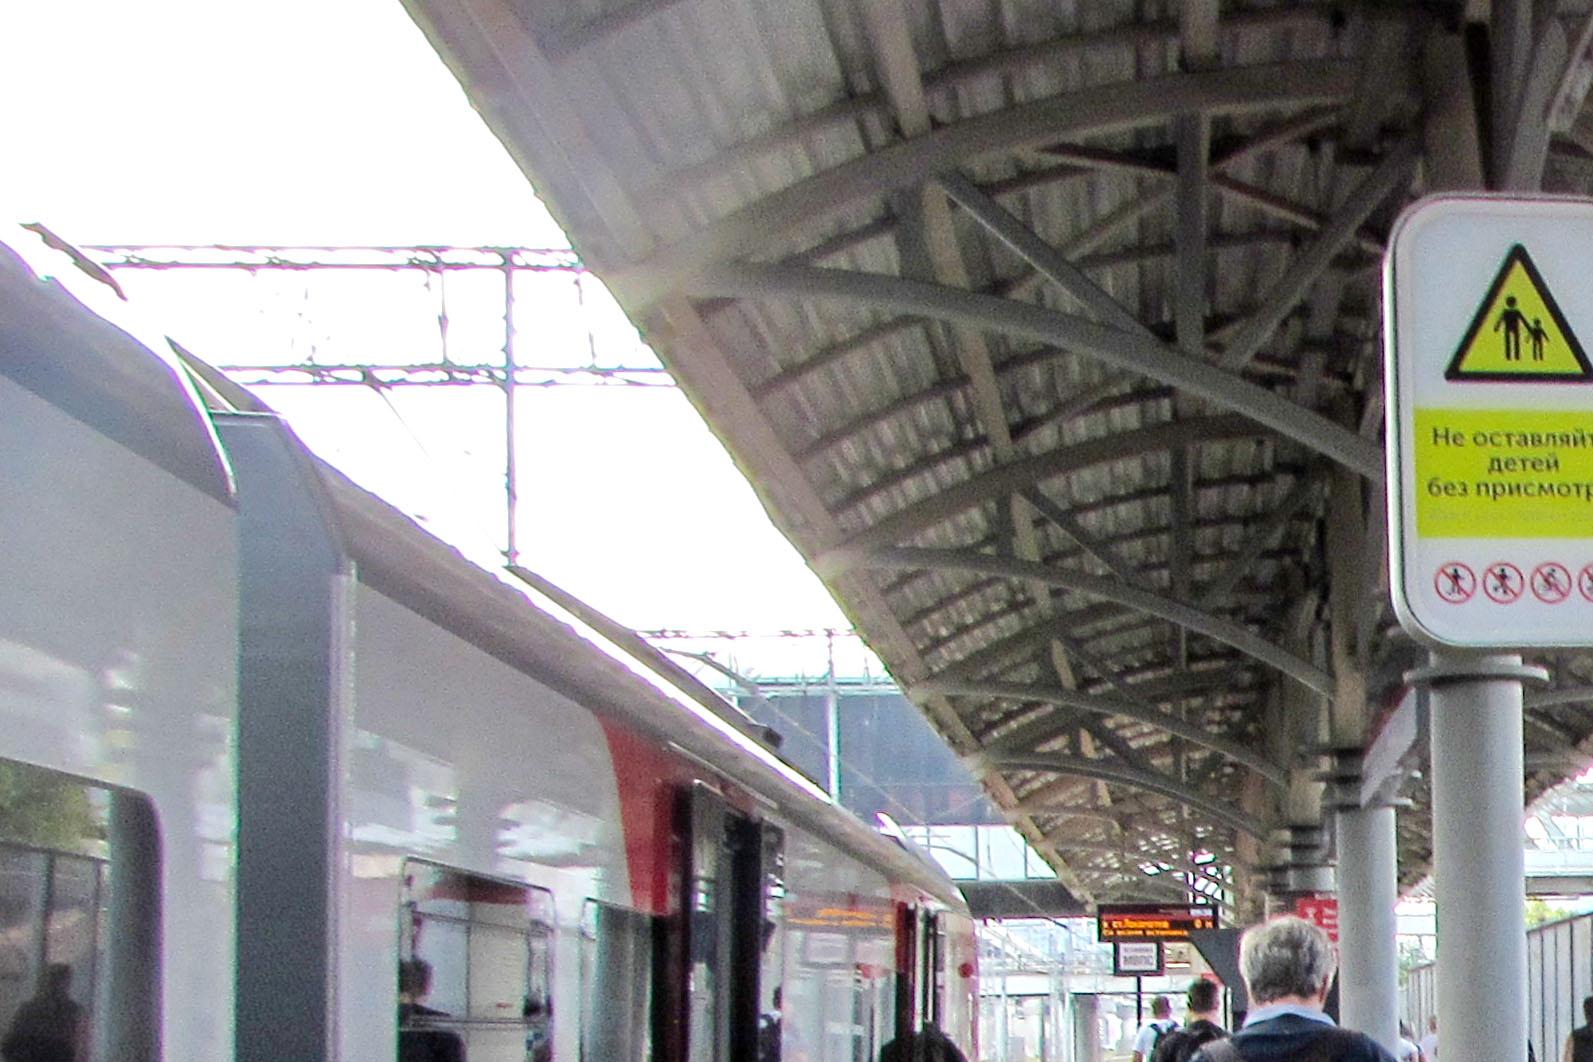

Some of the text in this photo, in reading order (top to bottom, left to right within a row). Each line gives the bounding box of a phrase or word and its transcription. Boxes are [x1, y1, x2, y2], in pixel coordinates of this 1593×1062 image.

[1432, 427, 1465, 447] Не
[1487, 453, 1560, 475] детей
[1427, 477, 1469, 498] без
